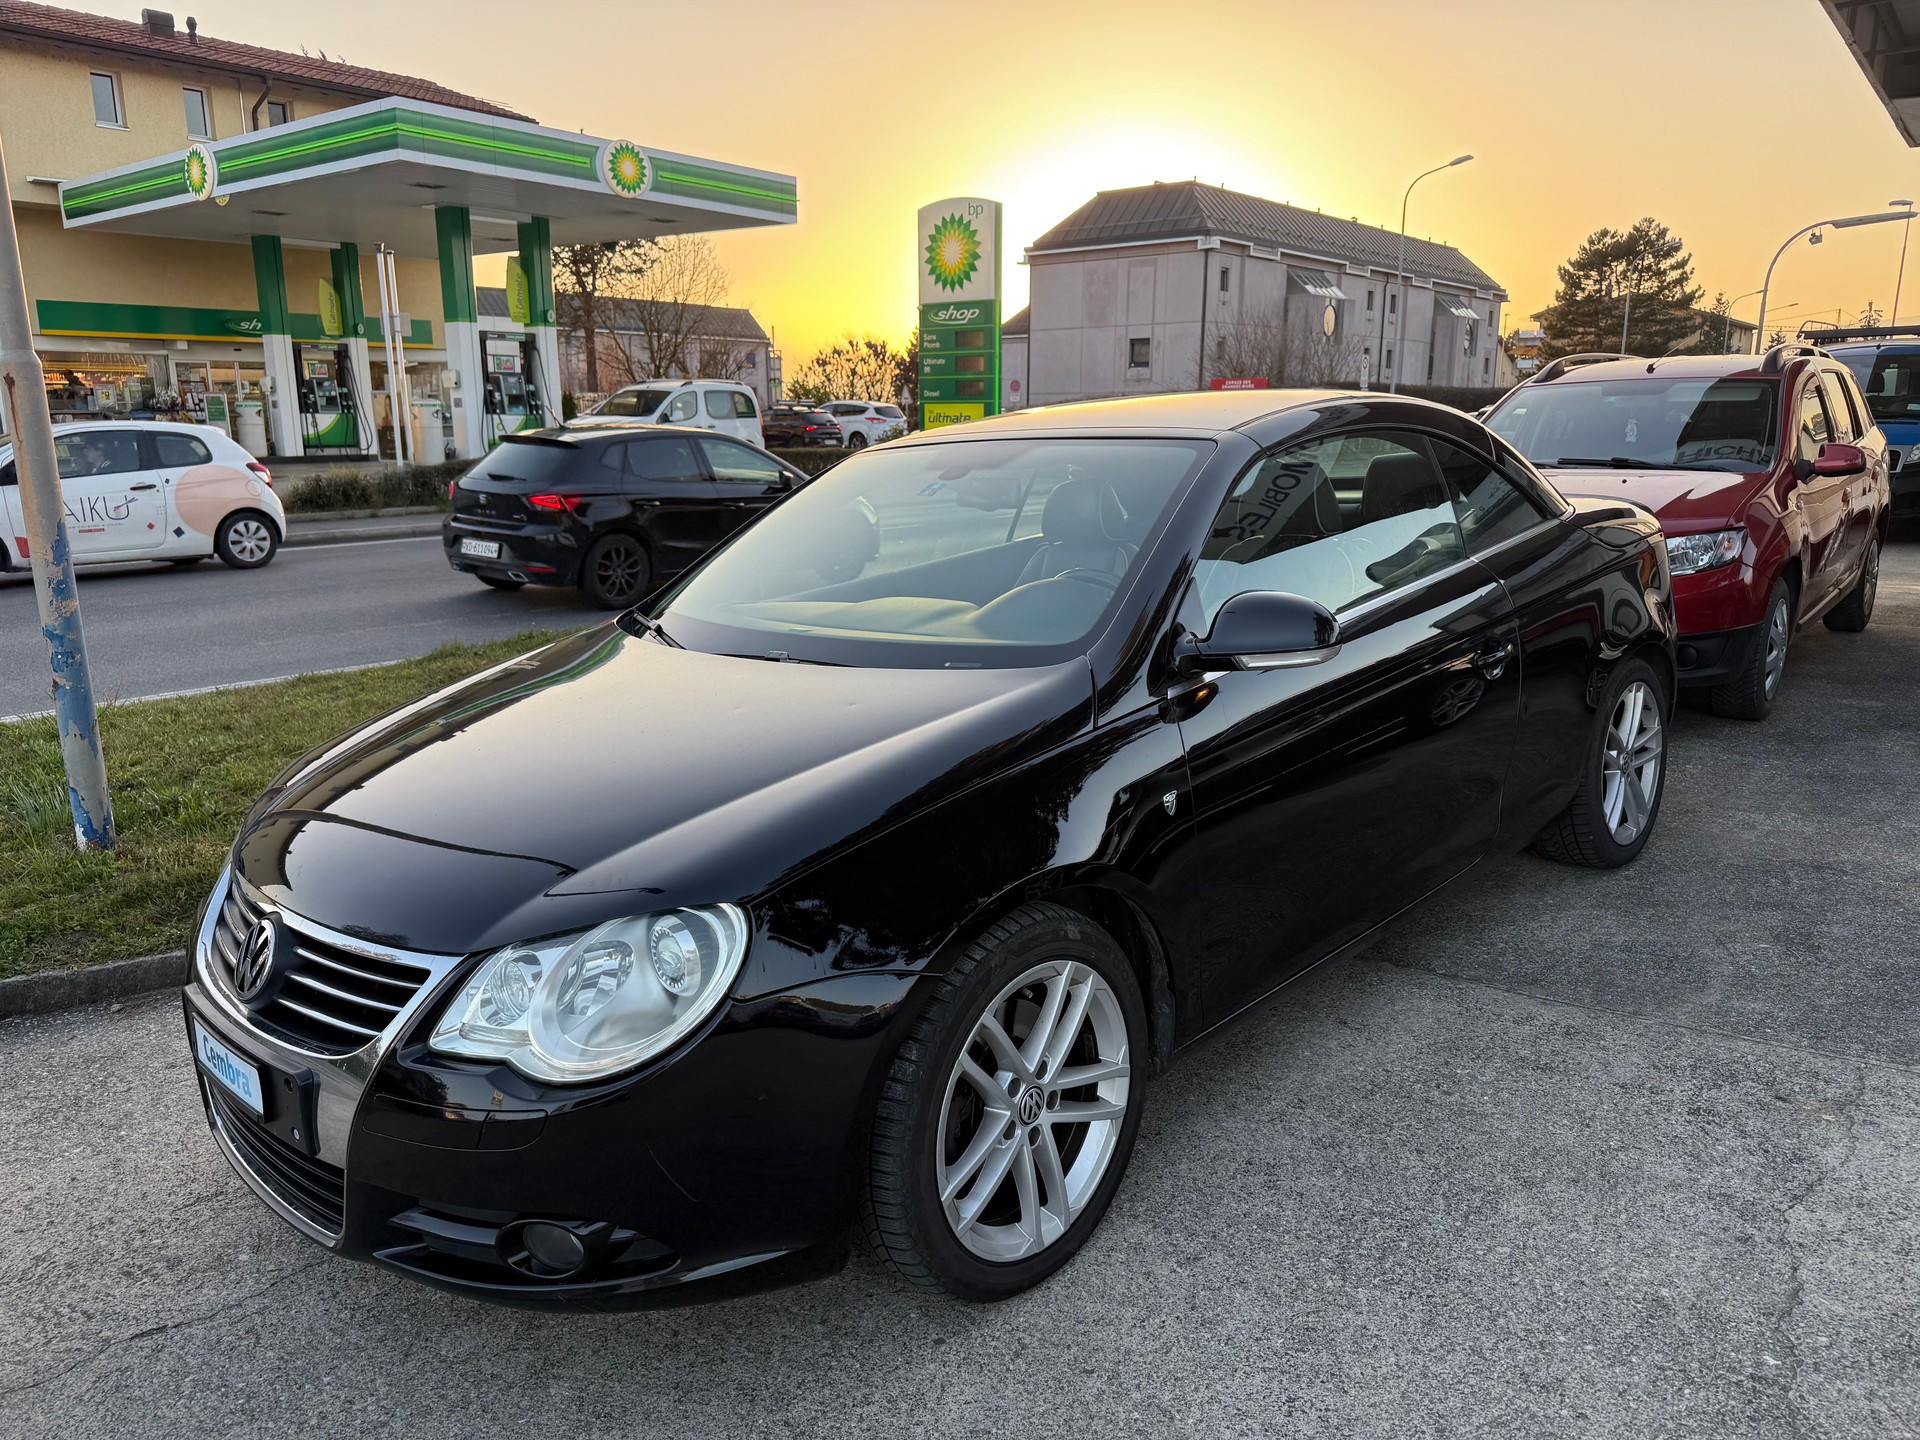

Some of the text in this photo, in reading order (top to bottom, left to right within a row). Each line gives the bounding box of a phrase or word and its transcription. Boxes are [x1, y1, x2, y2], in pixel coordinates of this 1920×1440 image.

[968, 202, 984, 219] bp
[937, 305, 980, 323] shop
[240, 318, 262, 330] sh
[923, 333, 937, 341] Sans
[928, 412, 971, 424] ultimate
[63, 495, 130, 522] AIKU
[203, 1034, 252, 1098] Cembra
